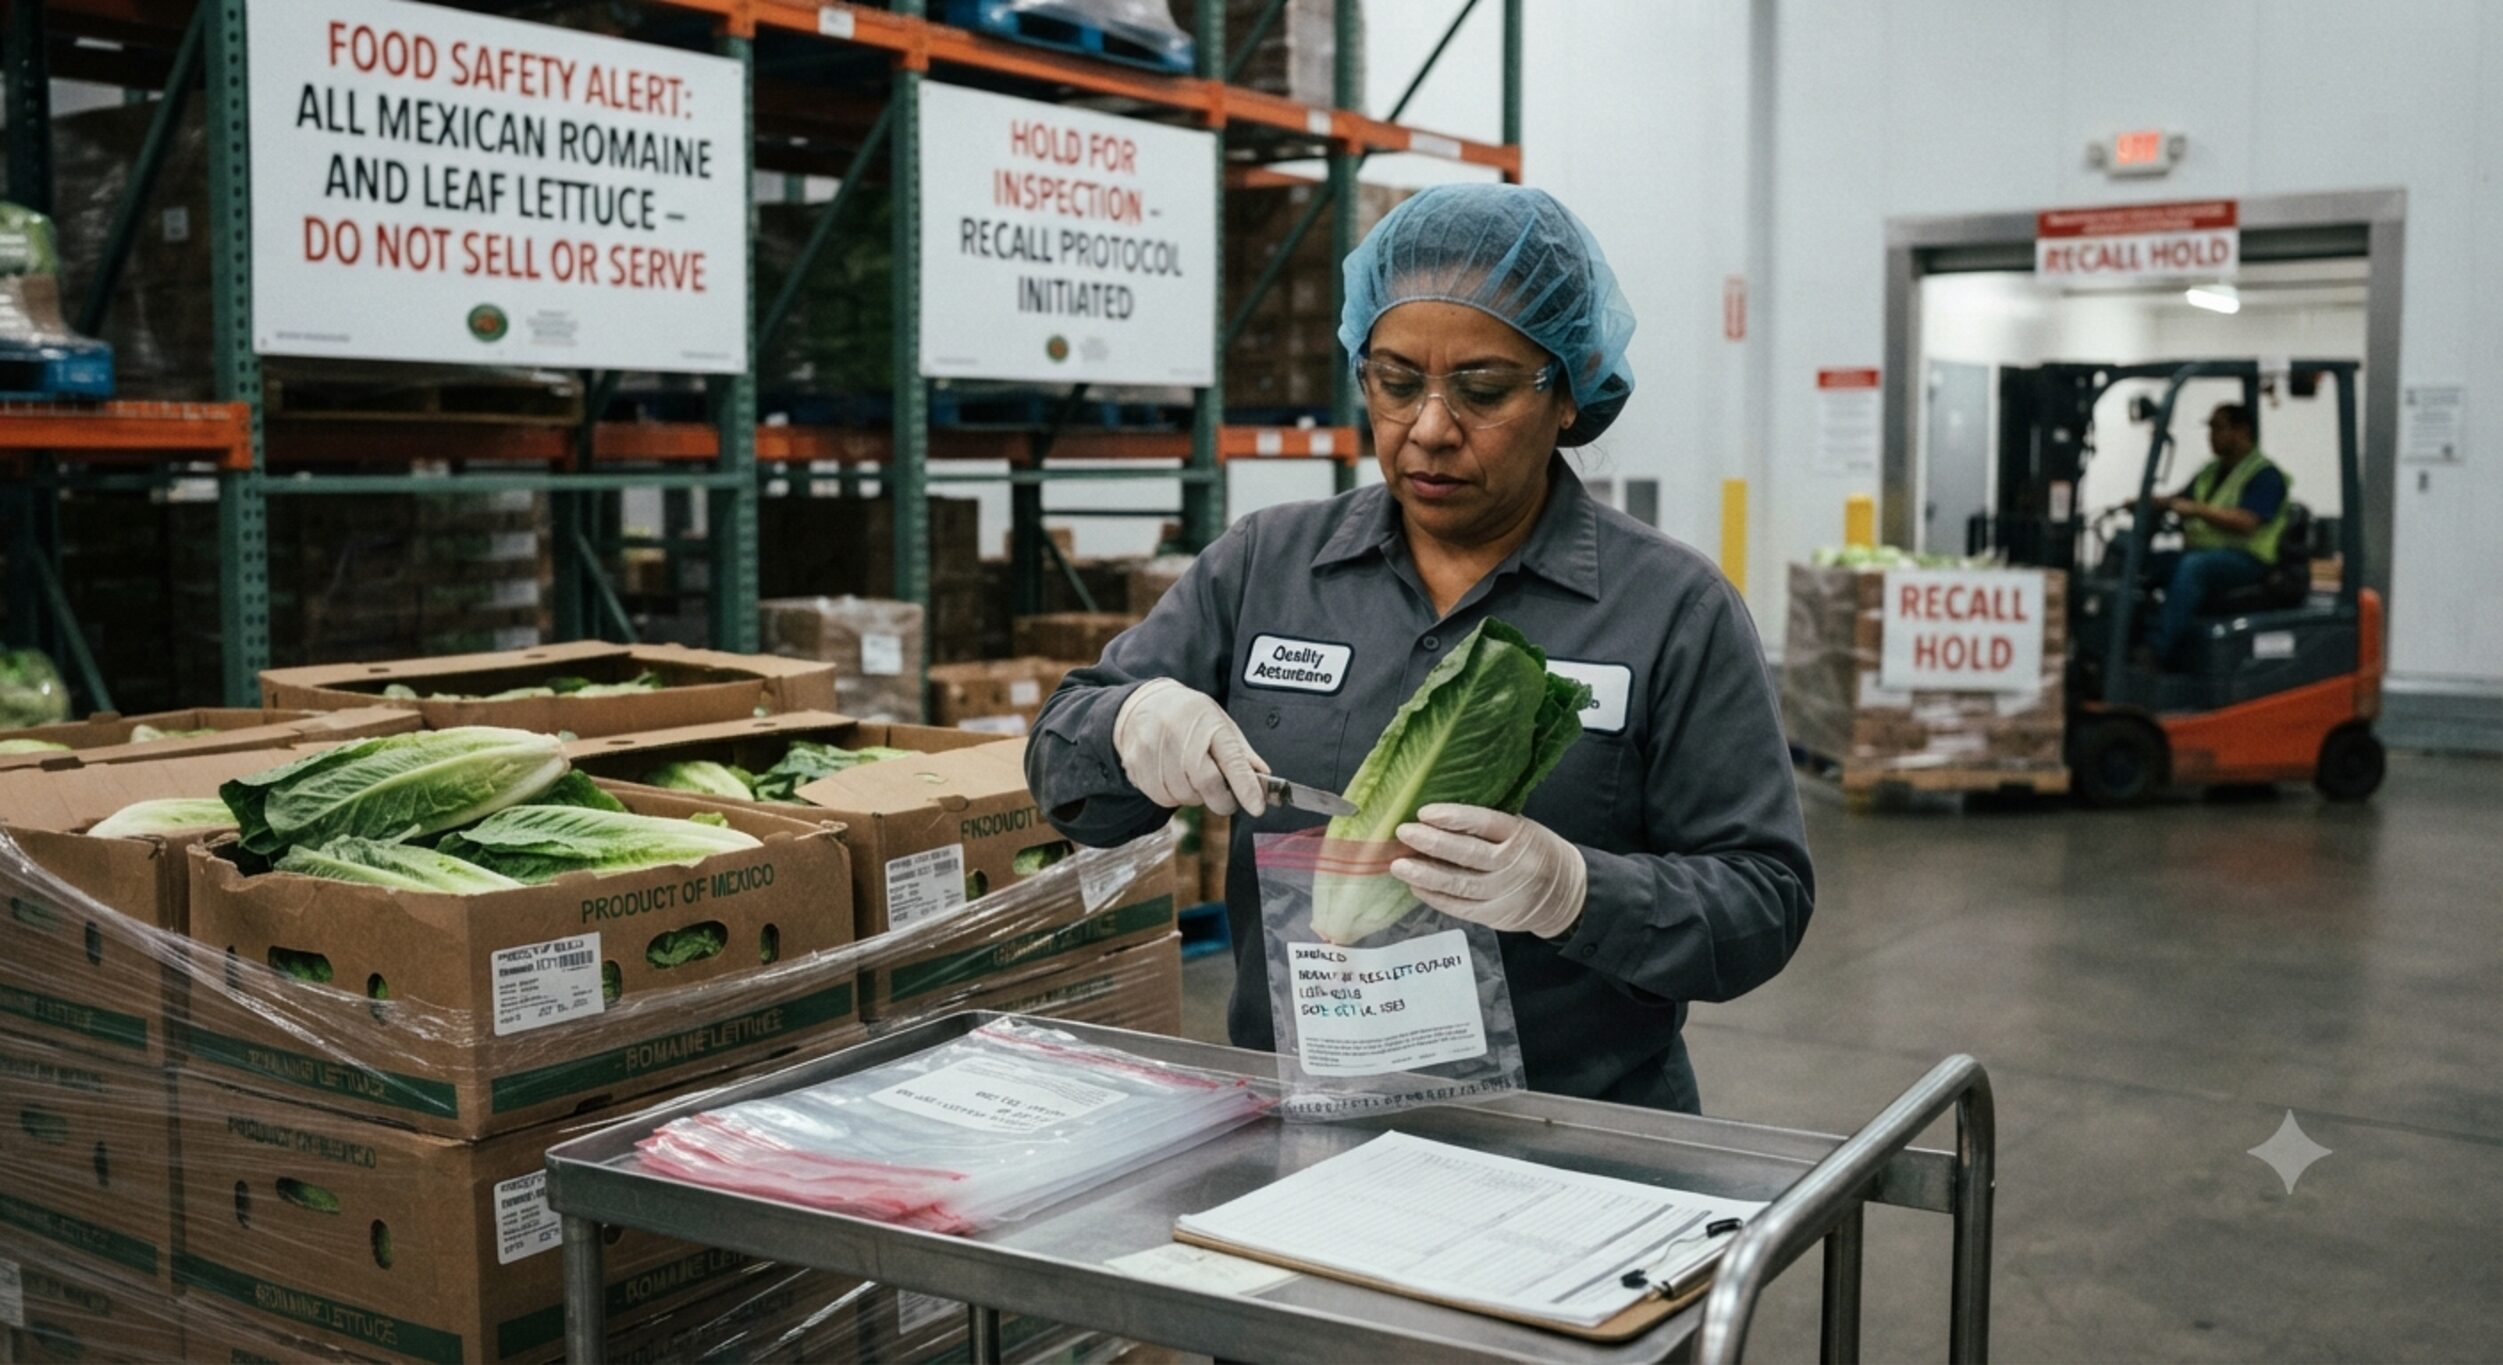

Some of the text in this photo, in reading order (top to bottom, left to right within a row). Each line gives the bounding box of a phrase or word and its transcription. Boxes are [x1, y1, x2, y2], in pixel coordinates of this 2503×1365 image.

[328, 21, 693, 120] FOOD SAFETY ALERT:
[297, 83, 712, 179] ALL MEXICAN ROMAINE
[1011, 119, 1137, 176] HOLD FOR
[325, 153, 409, 203] AND
[423, 163, 506, 214] LEAF
[519, 174, 656, 231] LETTUCE
[993, 168, 1143, 223] INSPECTION
[303, 216, 708, 293] DO NOT SELL OR SERVE
[960, 216, 1183, 277] RECALL PROTOCOL
[2045, 237, 2230, 273] RECALL HOLD
[1017, 275, 1136, 321] INITIATED
[1899, 583, 2029, 623] RECALL
[1914, 633, 2014, 672] HOLD
[581, 863, 775, 924] PRODUCT OF MEXICO
